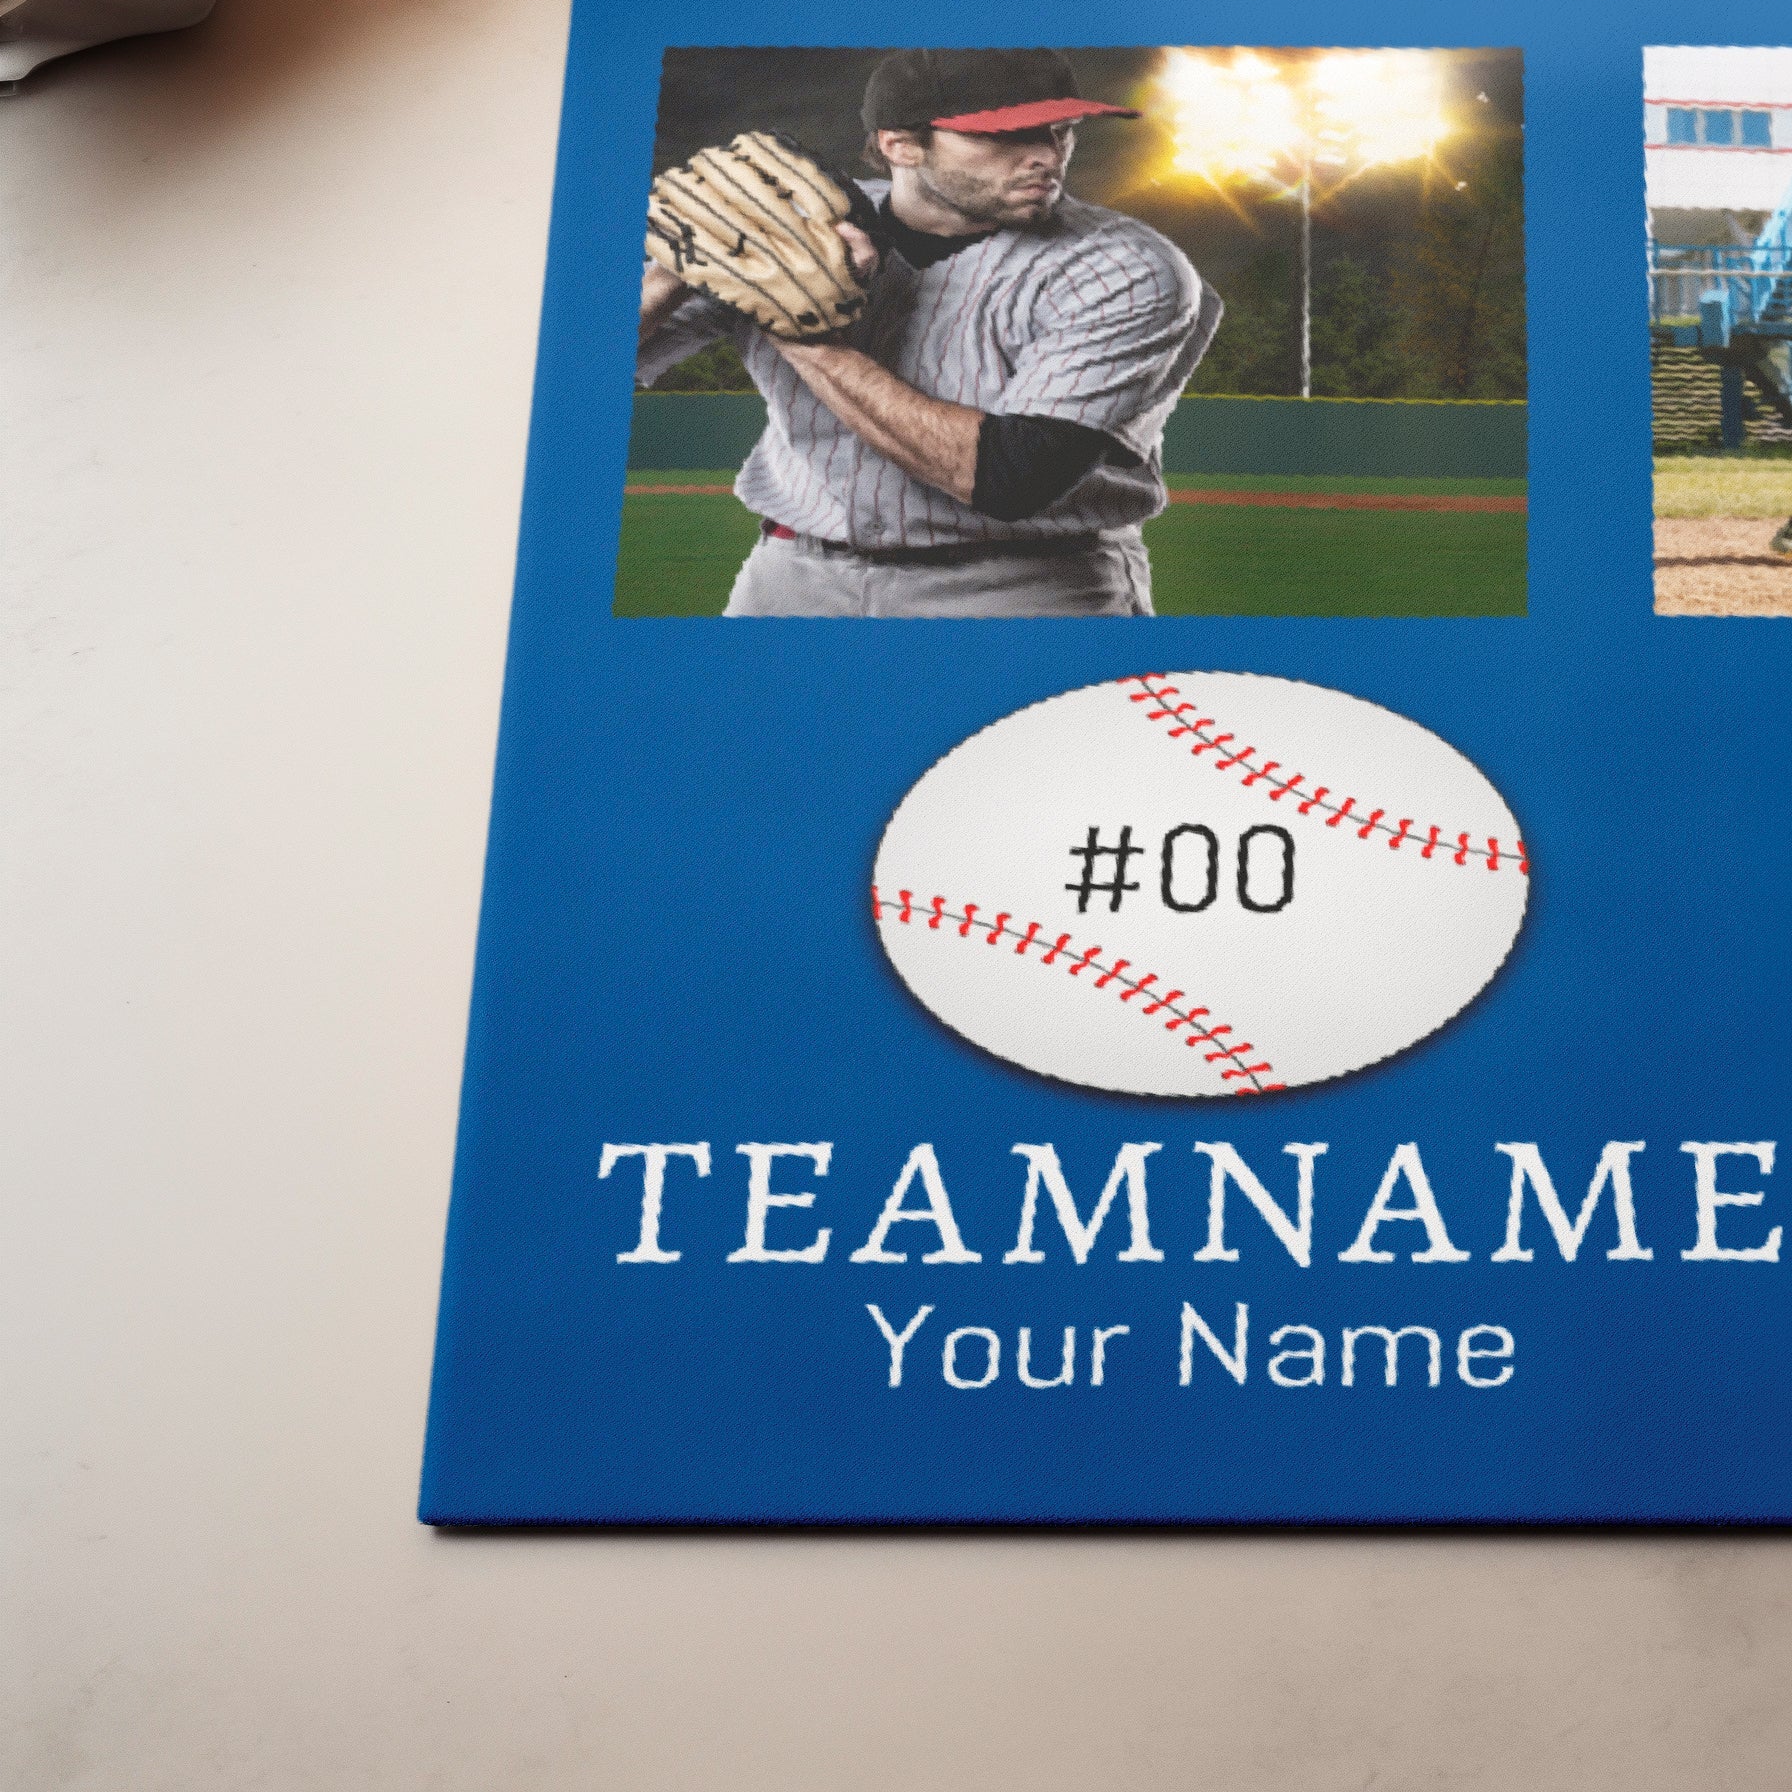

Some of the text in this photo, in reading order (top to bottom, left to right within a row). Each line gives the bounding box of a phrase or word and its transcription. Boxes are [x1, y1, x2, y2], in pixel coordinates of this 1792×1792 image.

[1065, 822, 1296, 914] #00
[598, 1141, 1783, 1268] TEAMNAME
[866, 1301, 1515, 1390] Your Name
